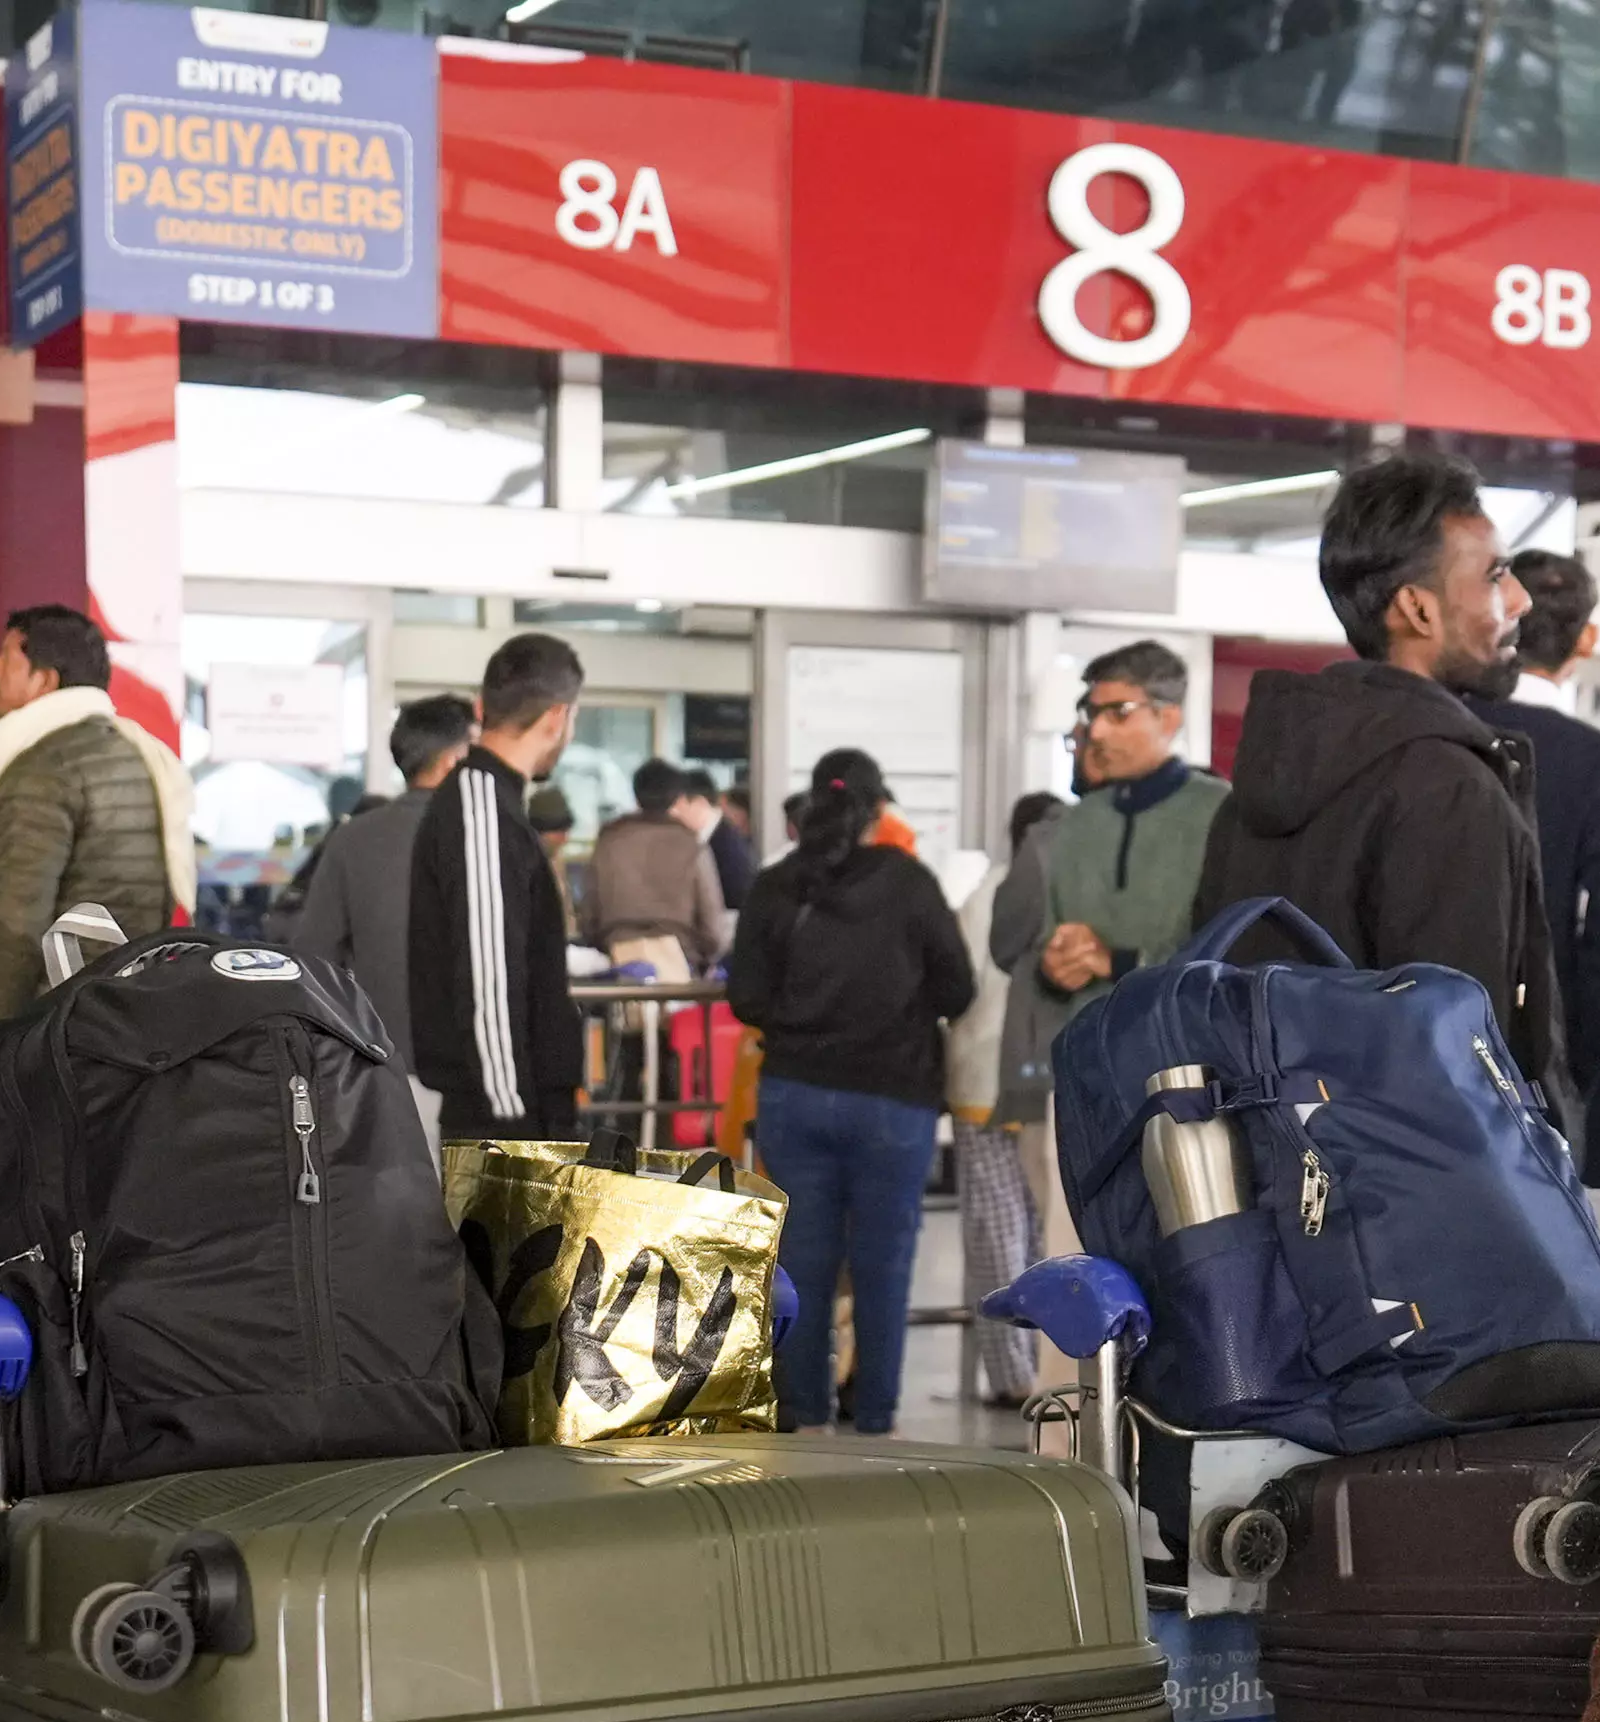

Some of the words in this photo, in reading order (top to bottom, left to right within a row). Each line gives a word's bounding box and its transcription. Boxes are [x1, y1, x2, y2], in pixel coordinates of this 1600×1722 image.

[177, 57, 276, 97] ENTRY
[281, 69, 343, 105] FOR
[122, 110, 394, 182] DIGIYATRA
[115, 162, 404, 232] PASSENGERS
[555, 159, 678, 255] 8A
[156, 216, 288, 251] (DOMESTIC
[292, 230, 366, 261] ONLY)
[1039, 143, 1192, 369] 8
[188, 274, 257, 305] STEP
[259, 281, 274, 307] 1
[276, 282, 313, 309] OF
[316, 285, 335, 313] 3
[1492, 264, 1591, 348] 8B
